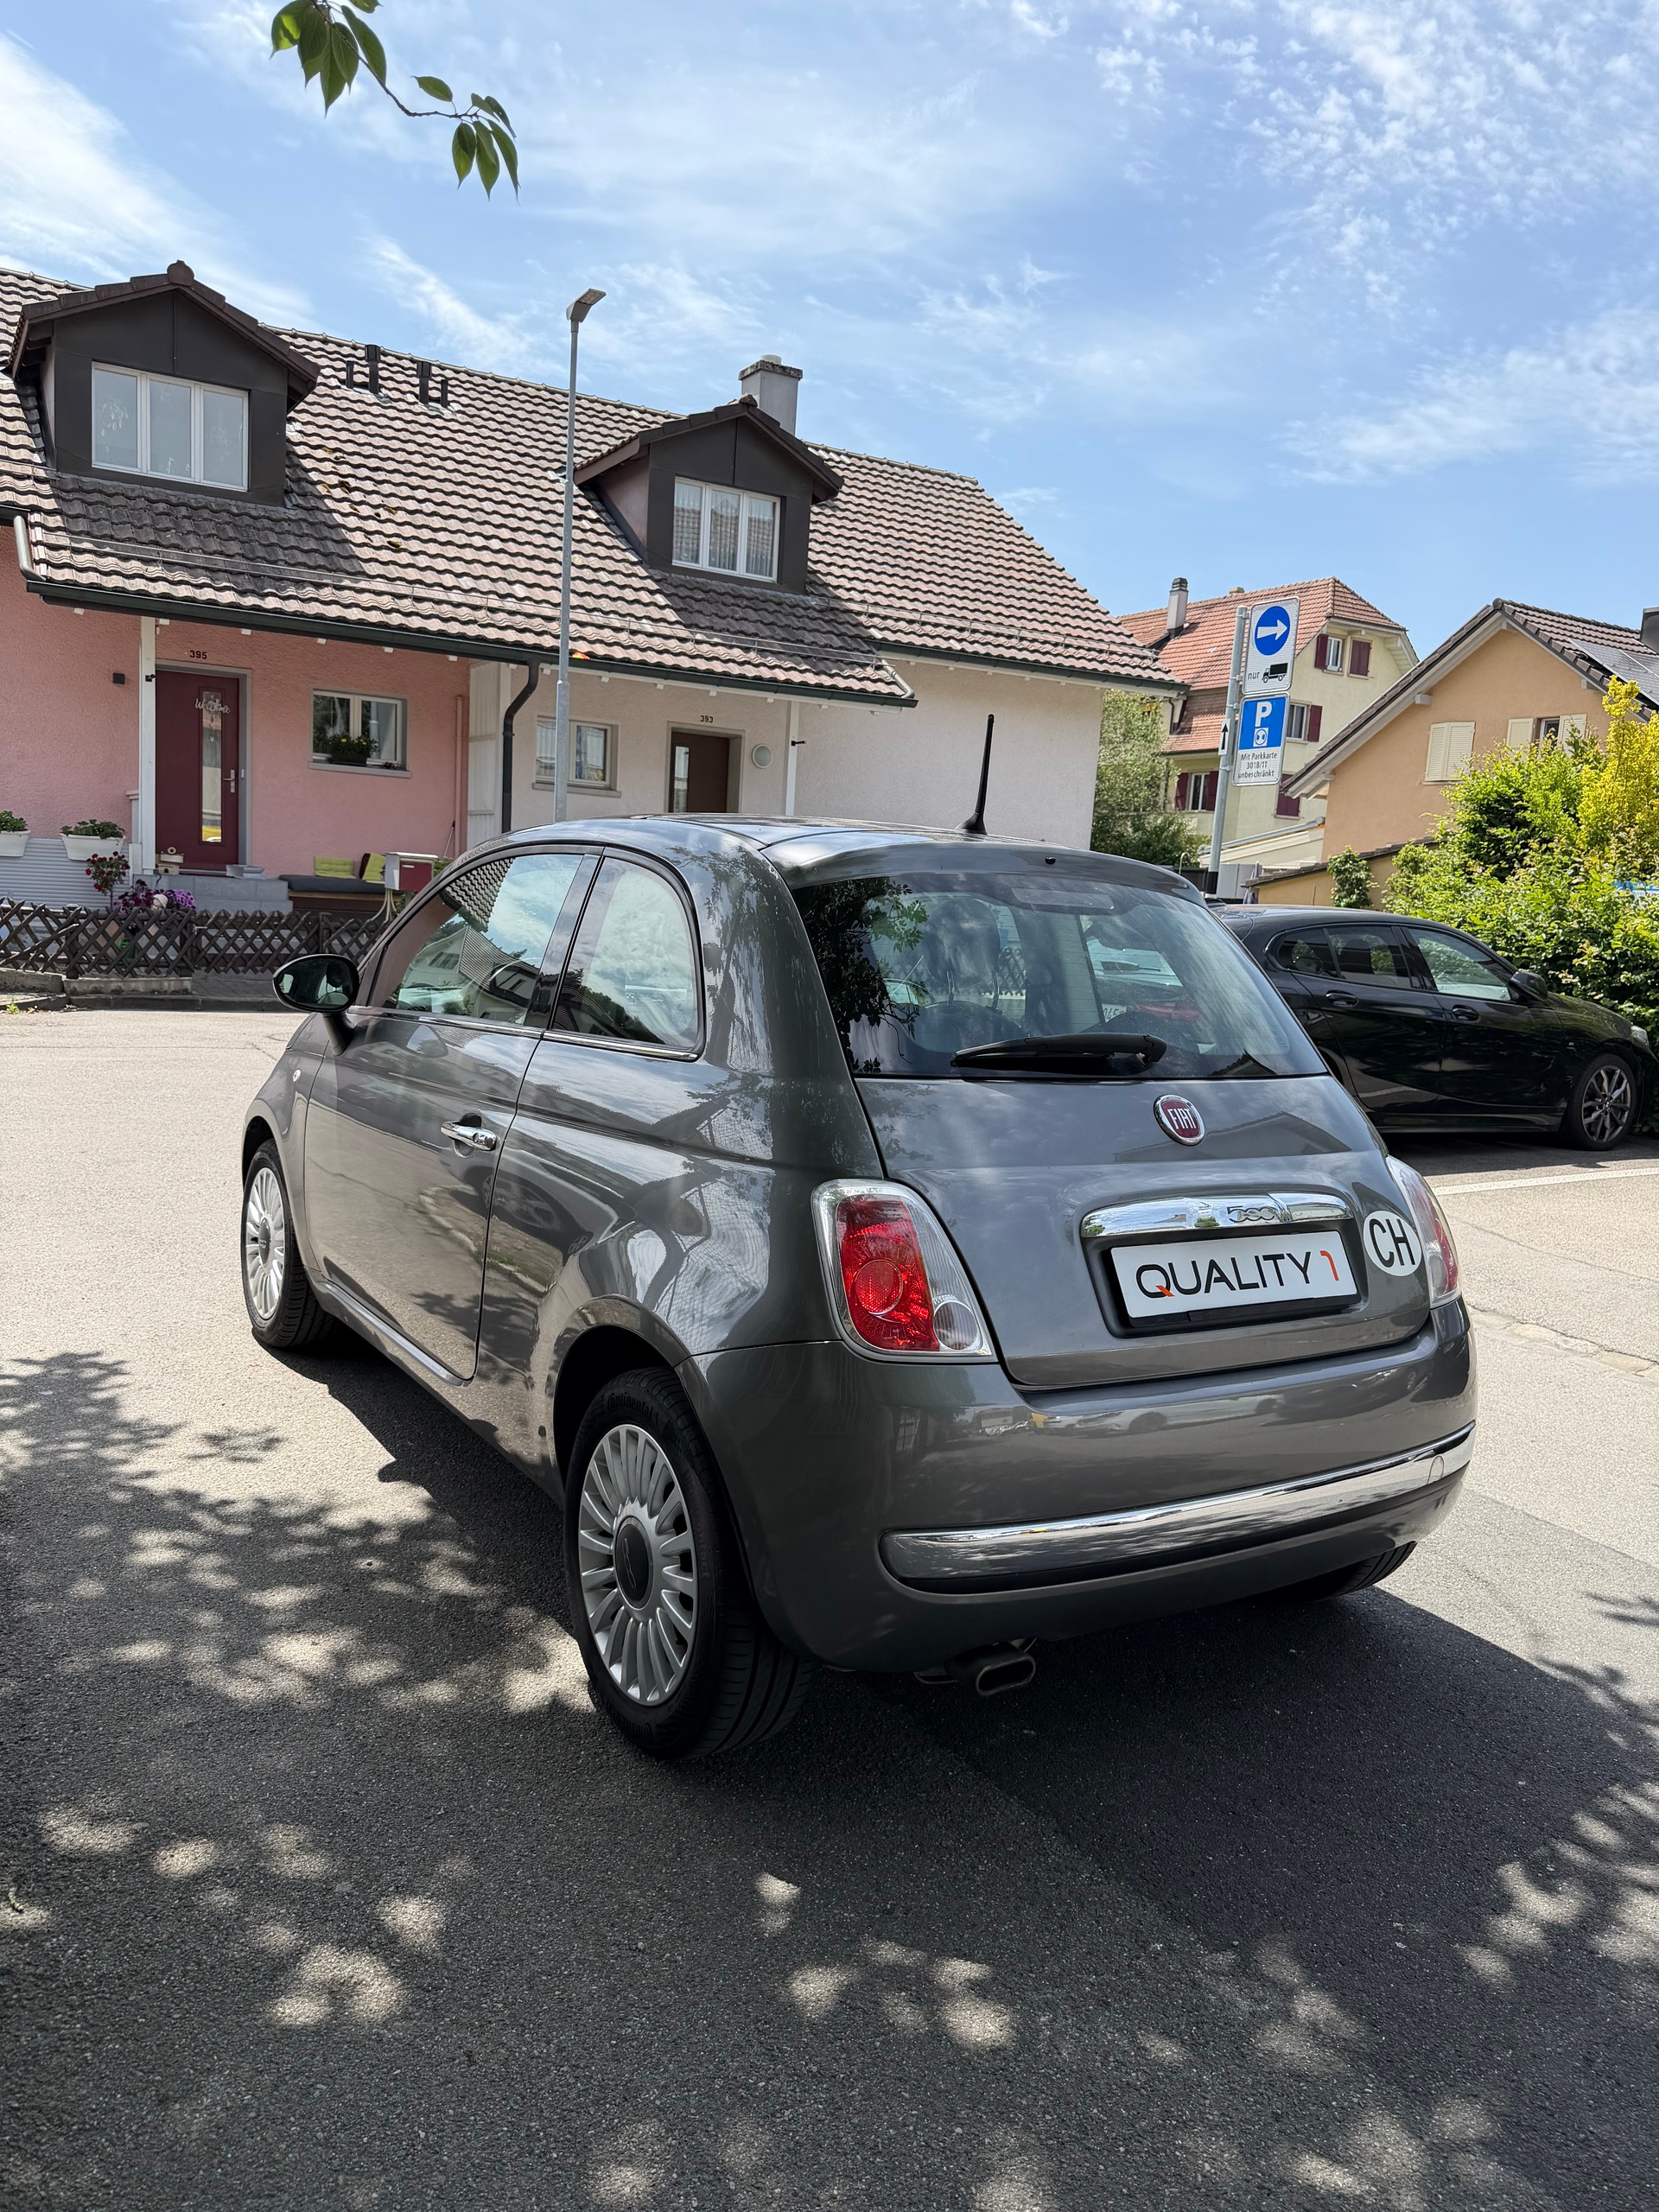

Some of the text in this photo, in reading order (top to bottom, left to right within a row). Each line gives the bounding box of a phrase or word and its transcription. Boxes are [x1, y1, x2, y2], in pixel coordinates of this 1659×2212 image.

[189, 650, 207, 659] 395
[1248, 671, 1260, 680] nur
[700, 715, 714, 723] 393
[1255, 701, 1272, 727] P
[1251, 752, 1277, 760] Parkkarte
[1237, 770, 1274, 779] unbeschränkt
[1167, 1108, 1197, 1129] FIAT
[1227, 1205, 1279, 1223] 500
[1369, 1217, 1415, 1268] CH
[1135, 1251, 1312, 1298] QUALITY
[607, 1391, 654, 1421] Continental
